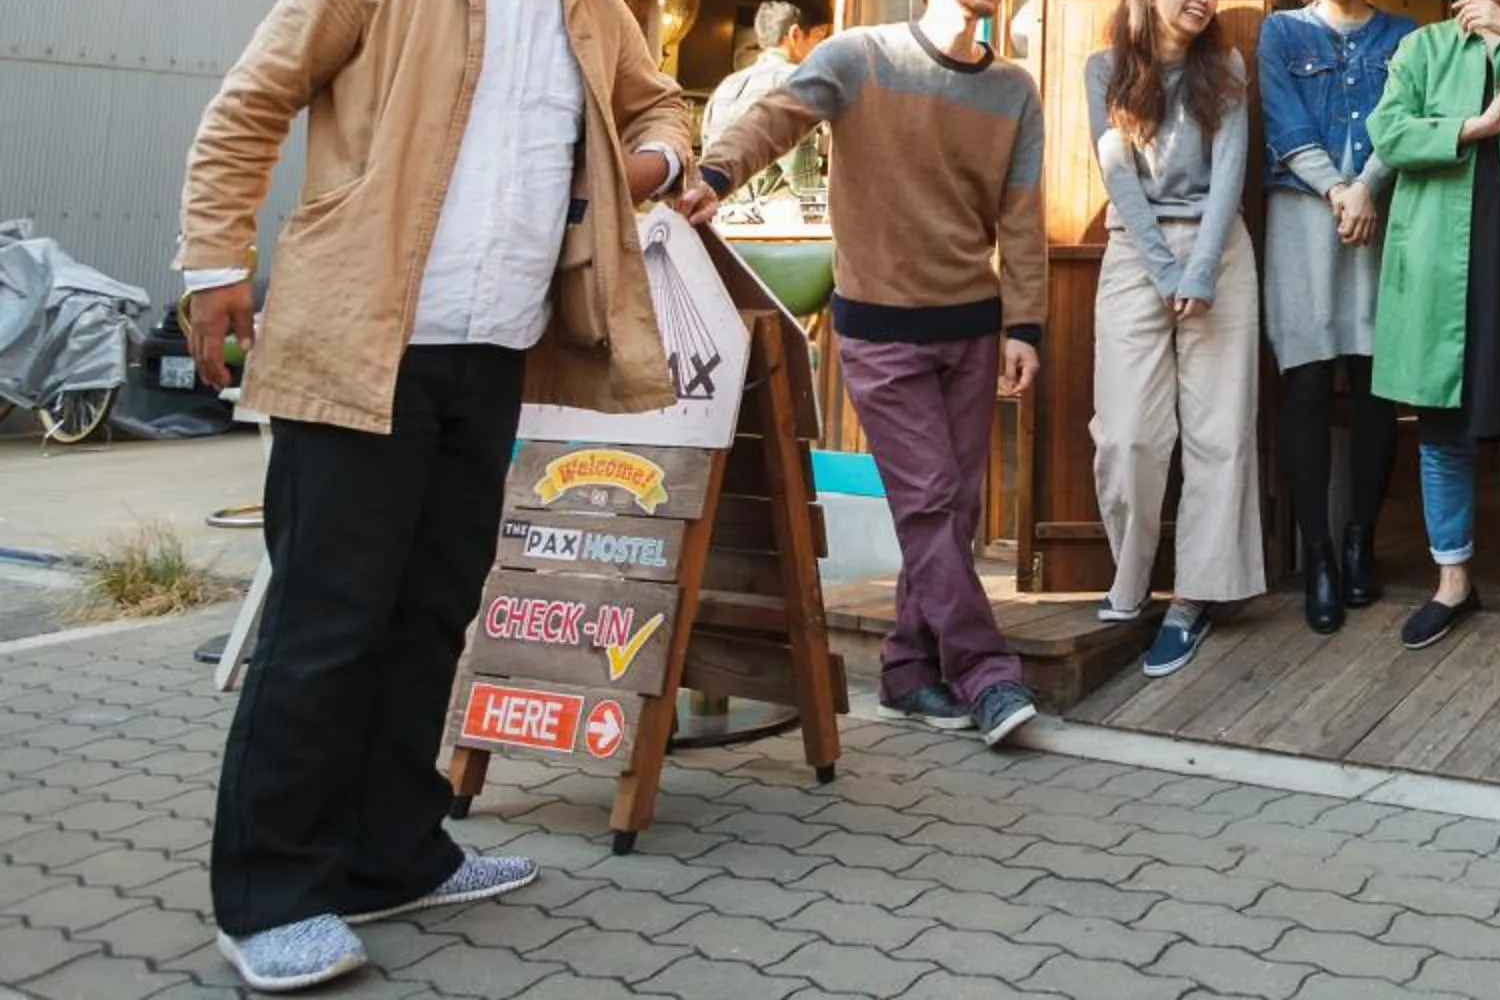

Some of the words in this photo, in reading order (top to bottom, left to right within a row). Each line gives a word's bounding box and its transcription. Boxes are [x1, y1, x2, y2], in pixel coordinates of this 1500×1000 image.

[557, 454, 656, 488] Welcome!
[504, 522, 528, 537] THE
[527, 530, 578, 557] PAX
[582, 532, 668, 567] HOSTEL
[481, 692, 564, 742] HERE
